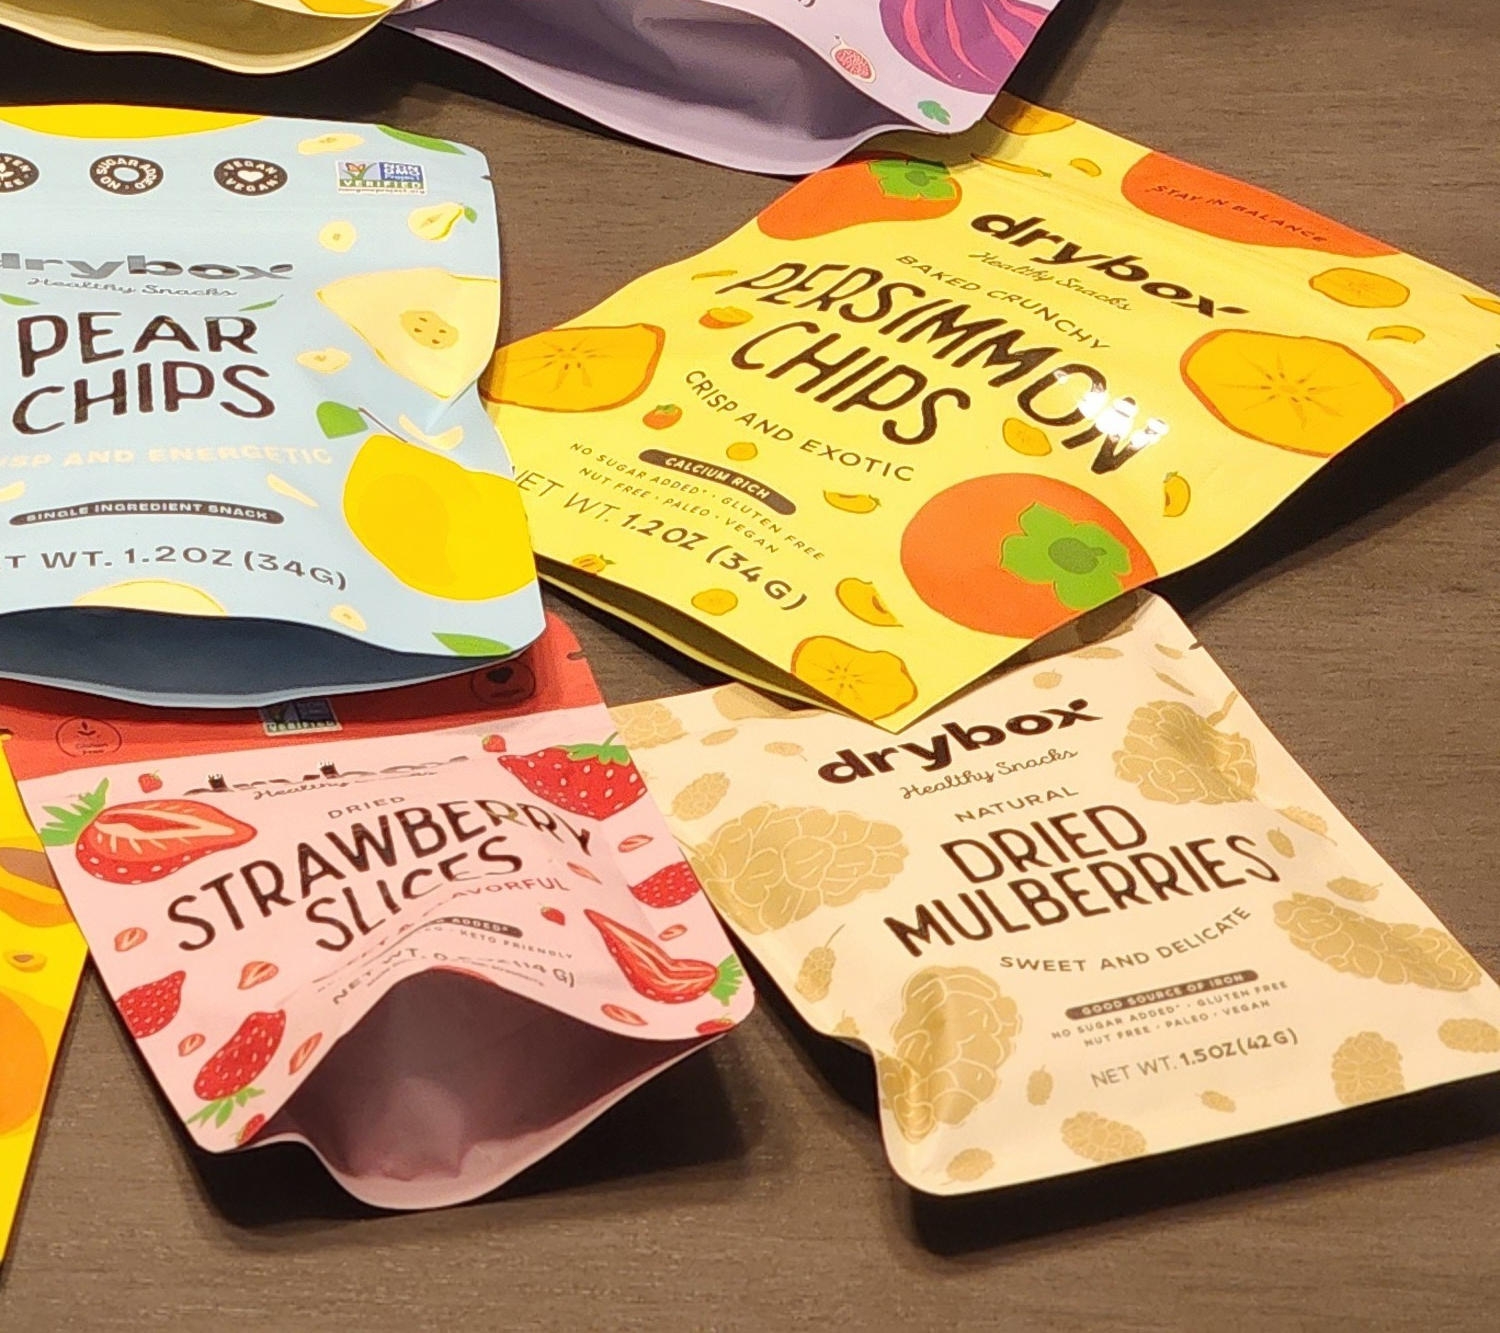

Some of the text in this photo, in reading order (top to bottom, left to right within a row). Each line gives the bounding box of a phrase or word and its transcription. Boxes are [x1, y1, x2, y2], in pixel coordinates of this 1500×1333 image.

[97, 157, 139, 176] SUGAR
[224, 160, 278, 176] VEGAN
[225, 176, 279, 193] VEGAN
[343, 179, 424, 189] VERIFIED
[1230, 203, 1330, 245] BALANCE
[27, 277, 238, 297] Healthy Snacks
[968, 250, 1135, 314] Healthy Snacks
[970, 212, 1251, 319] drybox
[894, 254, 1111, 351] BAKED CRUNCHY
[17, 312, 259, 378] PEAR
[734, 262, 1170, 476] PERSIMMON
[11, 361, 276, 436] CHIPS
[730, 321, 972, 447] CHIPS
[62, 445, 334, 467] AND ENERGETIC
[685, 369, 916, 484] CRISP AND EXOTIC
[569, 442, 826, 562] NO SUGAR GLUTEN FREE
[664, 456, 770, 501] CALCIUM RICH
[26, 503, 268, 522] SINGLE INGREDIENT SNACK
[579, 466, 779, 555] NUT FREE PALEO VEGAN
[41, 551, 114, 569] WT.
[243, 550, 348, 591] (34G)
[817, 698, 1104, 785] drybox
[899, 747, 1079, 801] Healthy Snacks
[328, 794, 406, 820] DRIED
[954, 785, 1081, 823] NATURAL
[939, 804, 1148, 885] DRIED
[167, 798, 592, 952] STRAWBERRY
[305, 835, 523, 953] SLICES
[882, 834, 1281, 958] MULBERRIES
[460, 930, 496, 944] KETO
[1000, 904, 1252, 973] SWEET AND DELICATE
[1082, 973, 1245, 1017] GOOD SOURCE IRON
[1090, 1055, 1178, 1088] NET WT.
